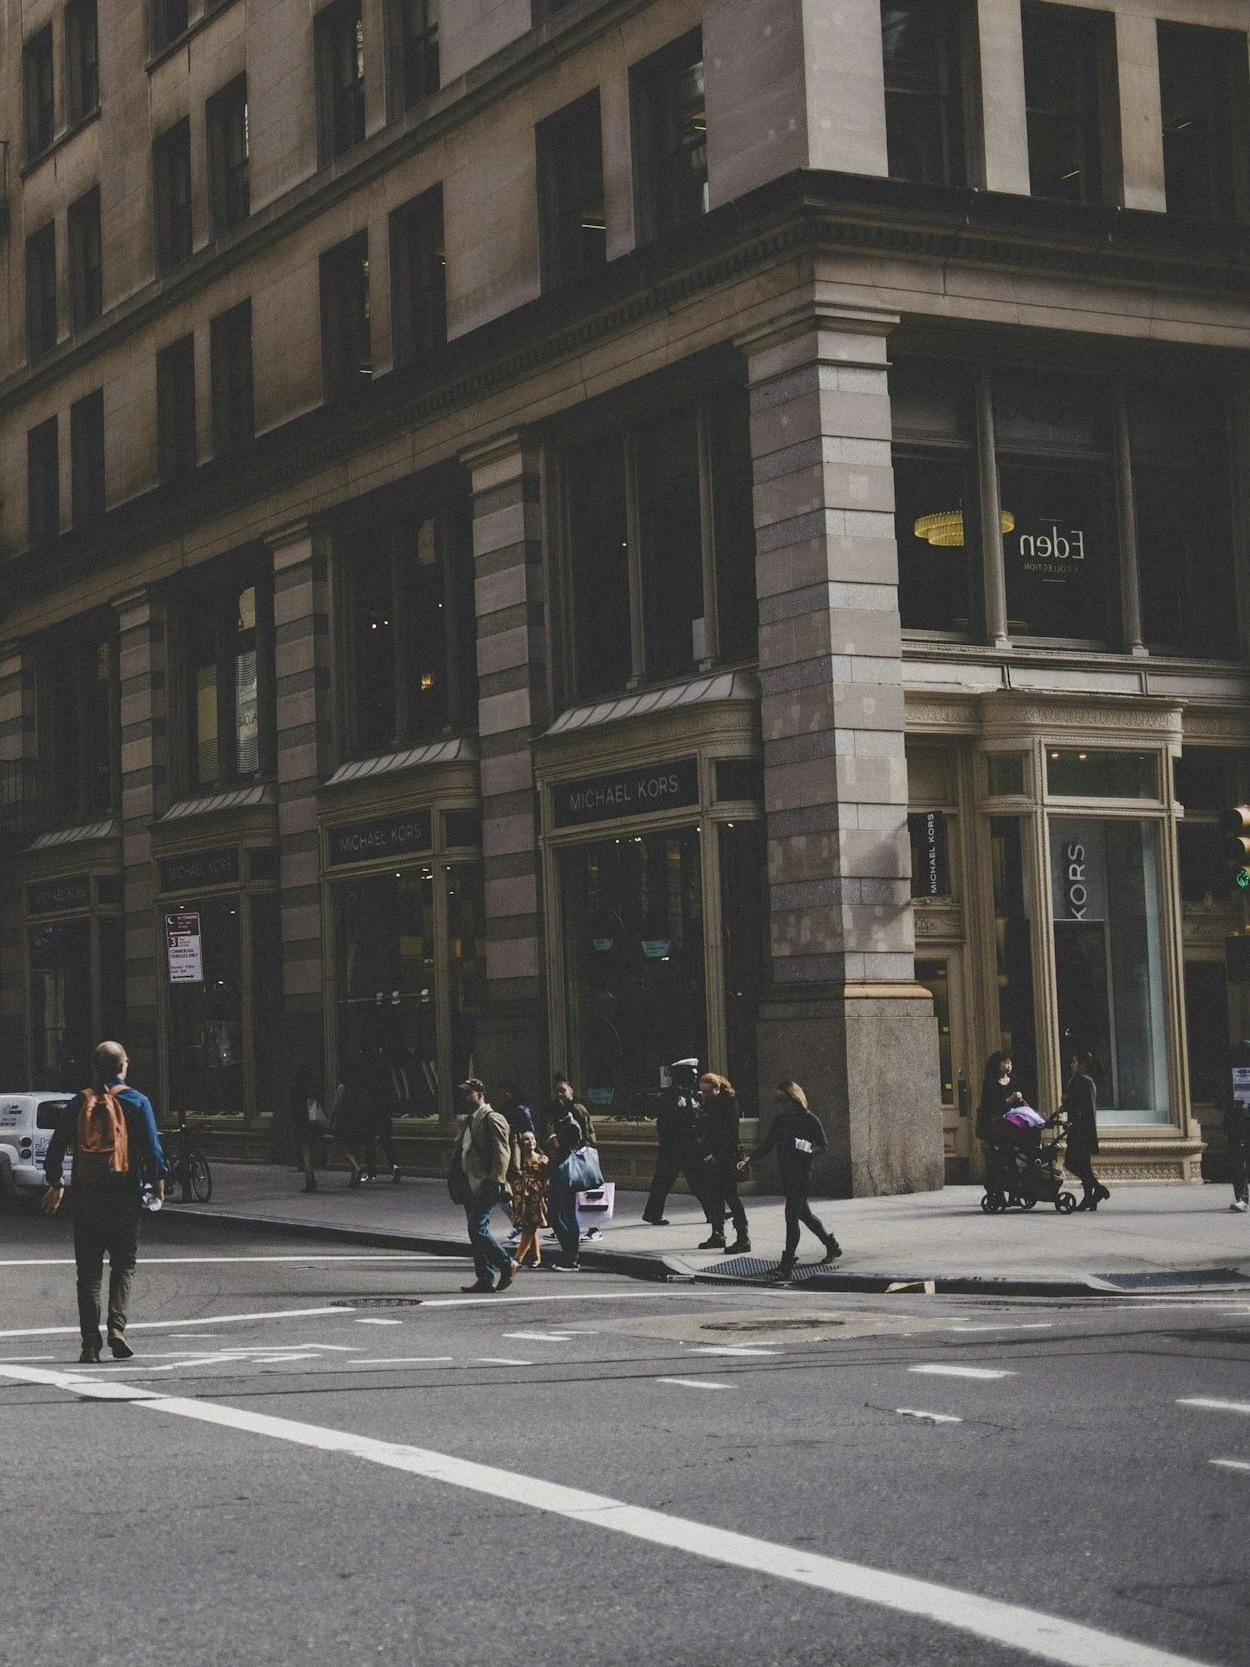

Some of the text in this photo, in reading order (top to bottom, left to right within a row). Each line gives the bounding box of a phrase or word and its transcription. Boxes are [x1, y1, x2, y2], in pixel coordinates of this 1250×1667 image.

[570, 774, 679, 811] MICHAEL KORS
[341, 823, 422, 851] MICHAEL KORS
[927, 813, 937, 894] MICHAEL KORS
[1067, 843, 1087, 920] KORS
[171, 938, 177, 947] 3
